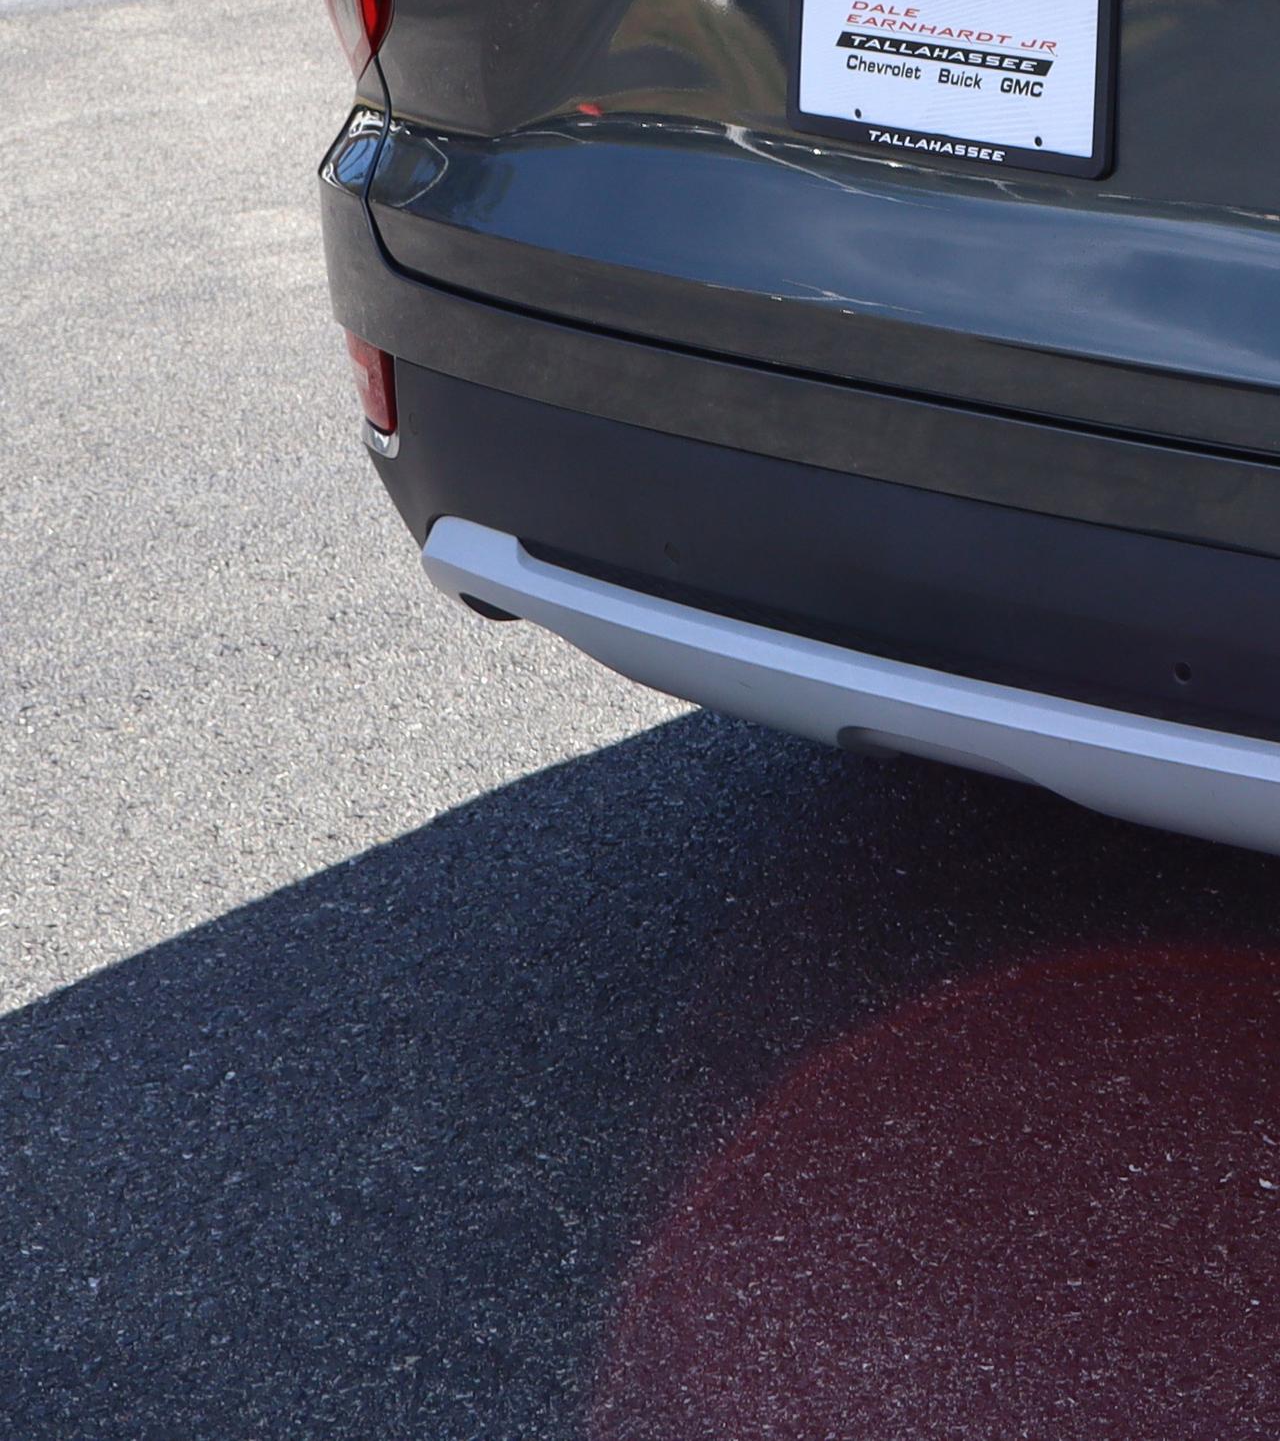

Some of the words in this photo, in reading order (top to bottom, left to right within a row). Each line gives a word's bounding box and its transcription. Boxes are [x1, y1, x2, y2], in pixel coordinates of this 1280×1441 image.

[851, 1, 920, 18] DALE
[846, 14, 1013, 44] EARNHARDT
[850, 35, 1038, 72] TALLAHASSEE
[846, 55, 921, 80] Chevrolet
[938, 69, 982, 89] Buick
[1000, 77, 1044, 98] GMC
[869, 130, 1006, 162] TALLAHASSEE
